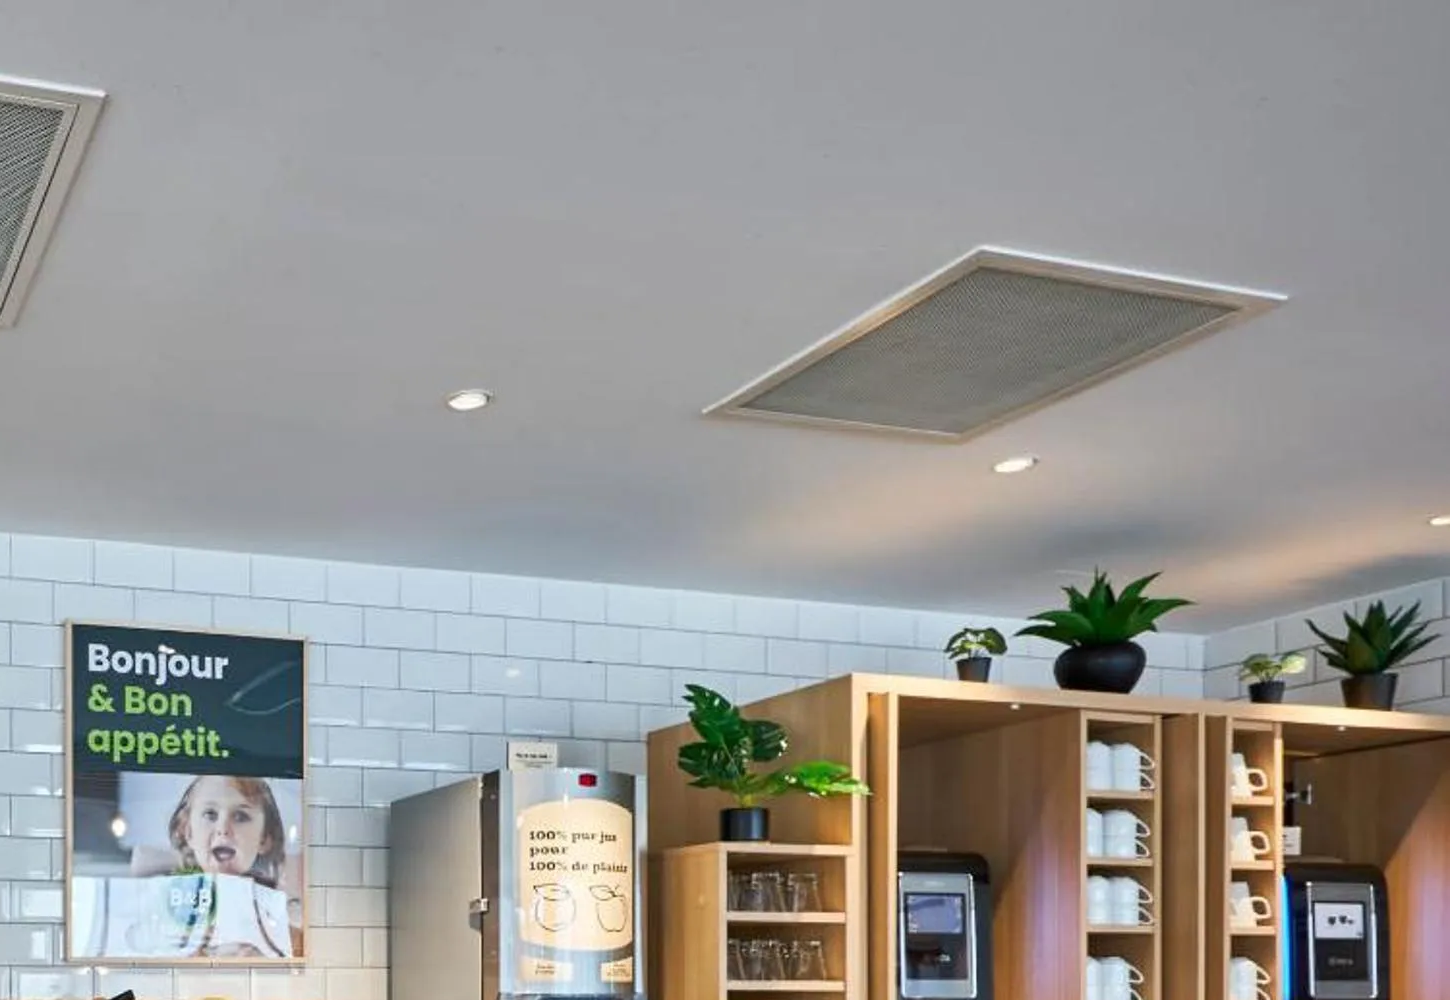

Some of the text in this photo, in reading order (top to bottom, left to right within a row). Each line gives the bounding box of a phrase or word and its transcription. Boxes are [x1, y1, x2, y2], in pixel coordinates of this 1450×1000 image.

[87, 642, 229, 685] Bonjour
[87, 683, 192, 717] & Bon
[87, 724, 230, 764] appétit.
[529, 830, 568, 841] 100%
